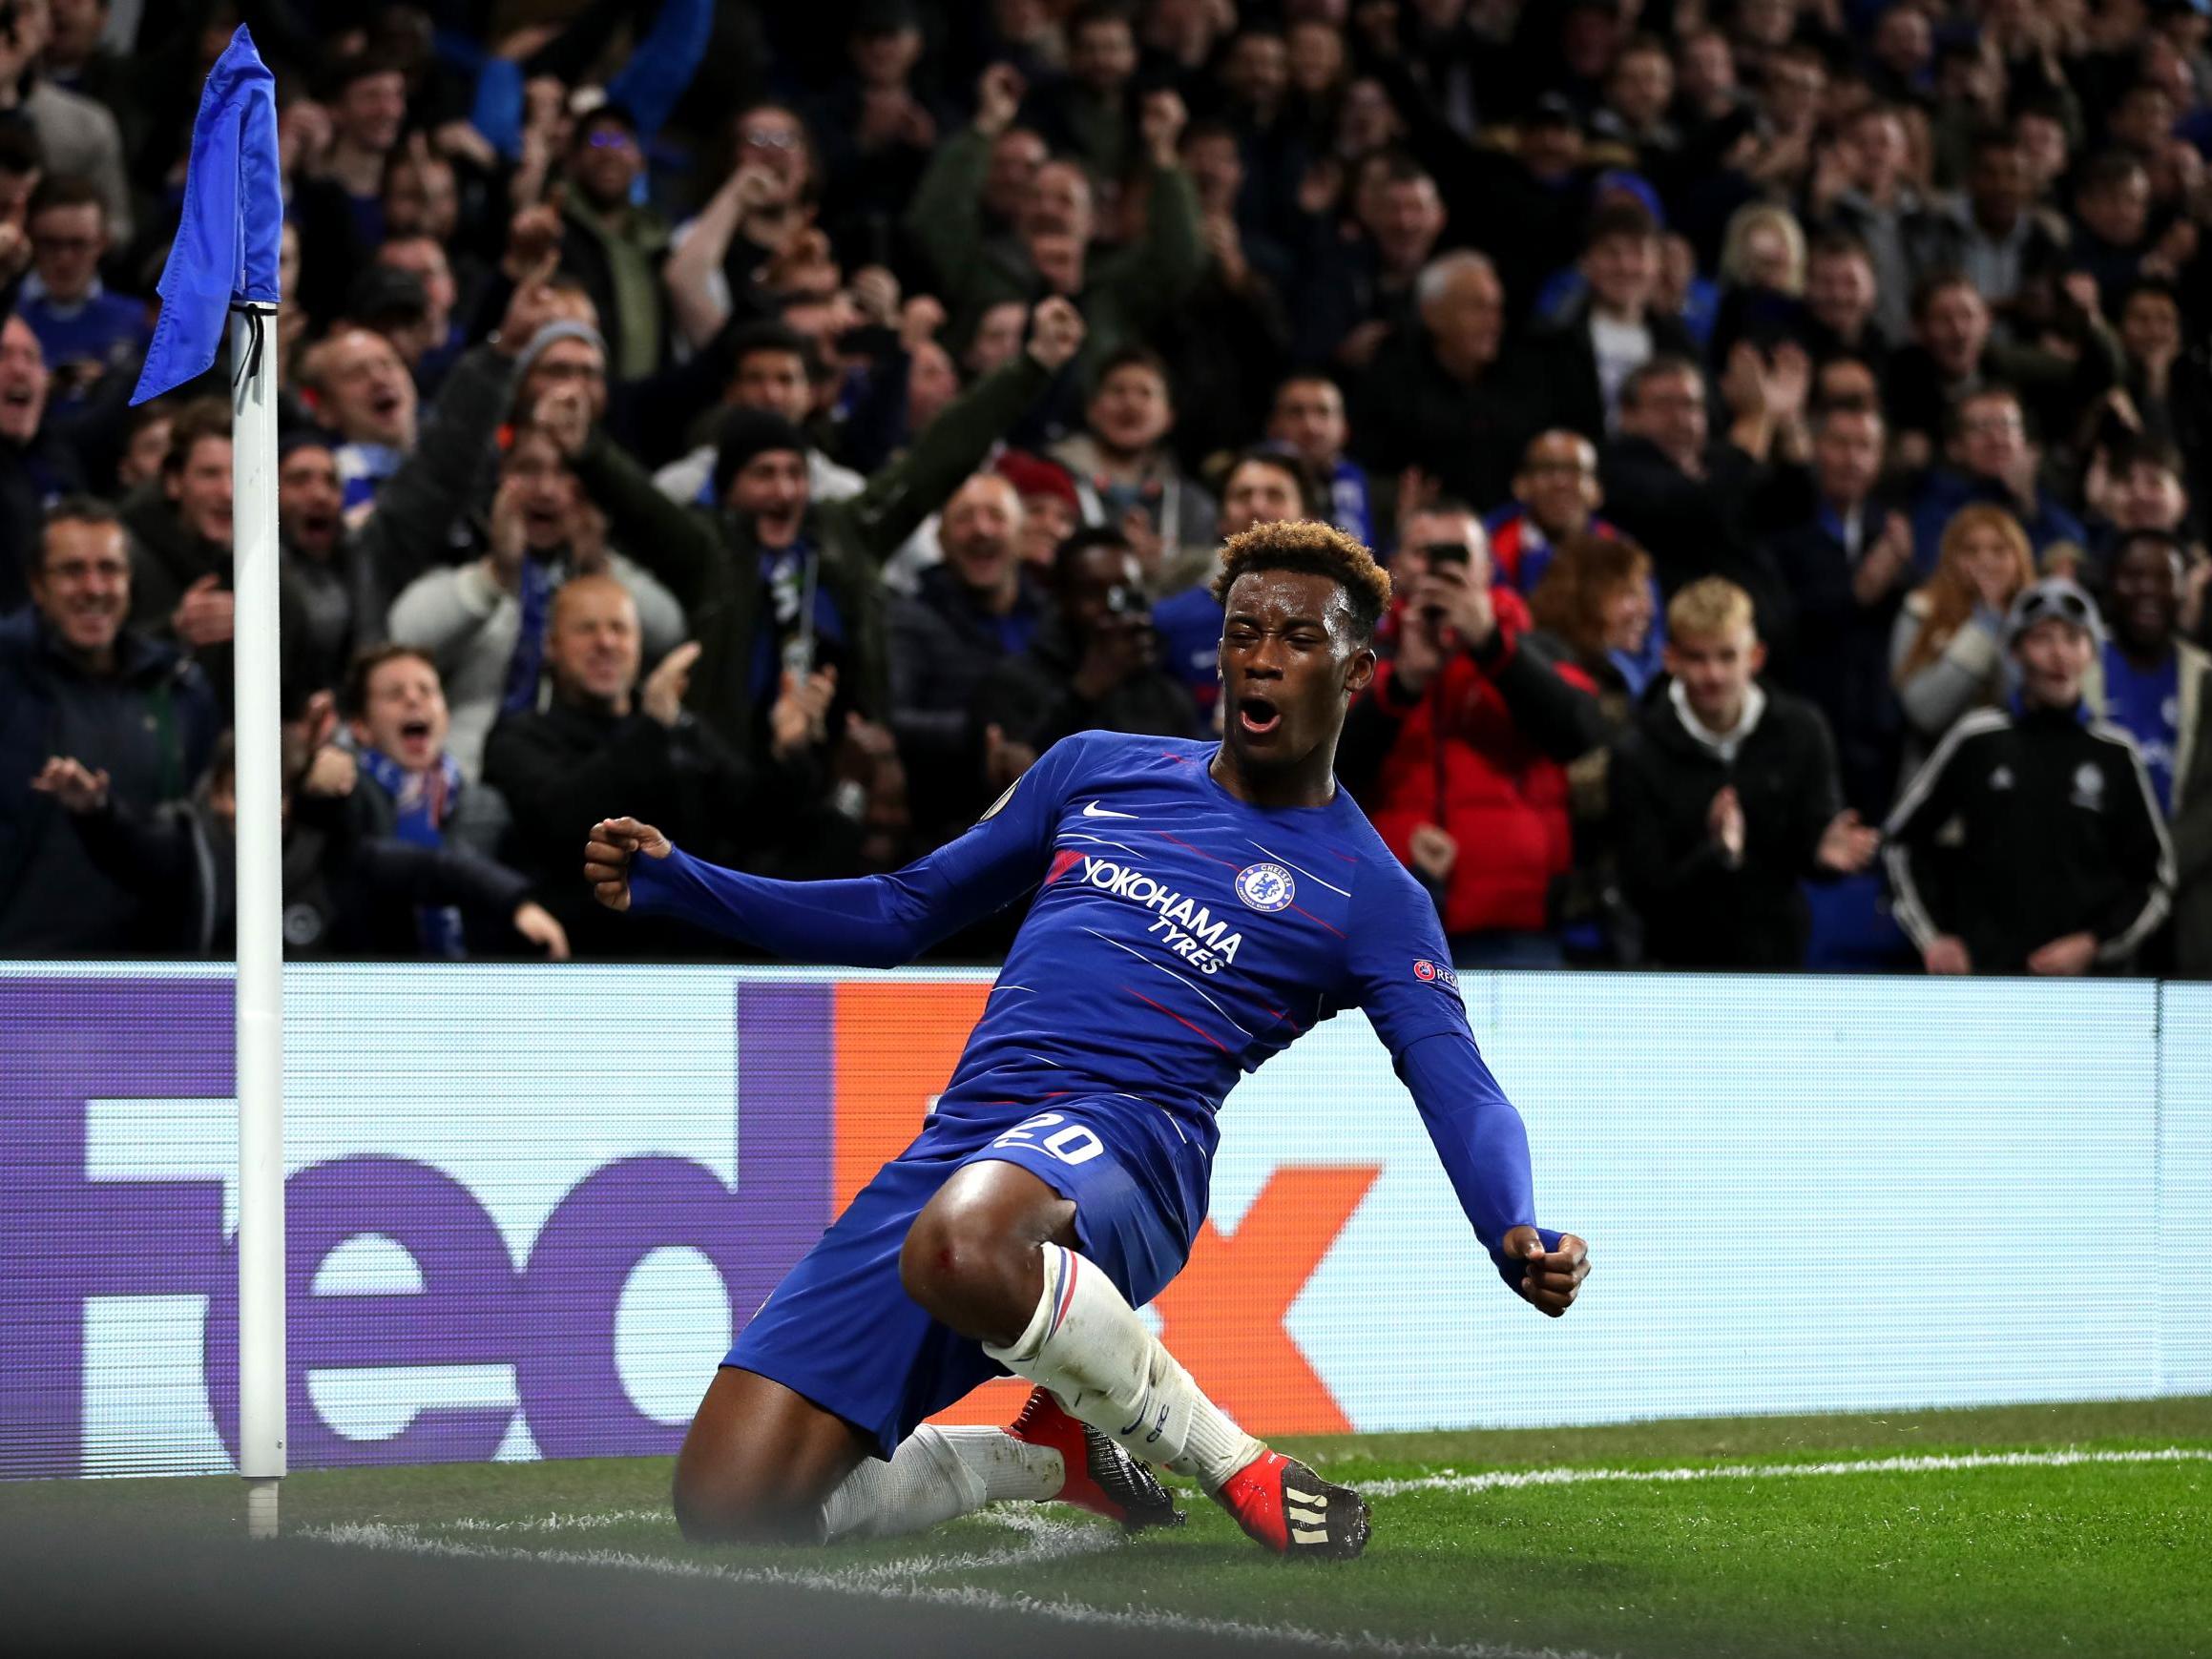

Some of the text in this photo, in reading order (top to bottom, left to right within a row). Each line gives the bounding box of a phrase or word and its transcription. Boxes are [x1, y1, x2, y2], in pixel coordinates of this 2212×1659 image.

[1261, 864, 1292, 887] CHELSEA
[1080, 856, 1242, 964] YOKOHAMA
[1147, 915, 1225, 975] TYRES
[993, 1112, 1104, 1166] 20
[1146, 1403, 1170, 1443] CFC
